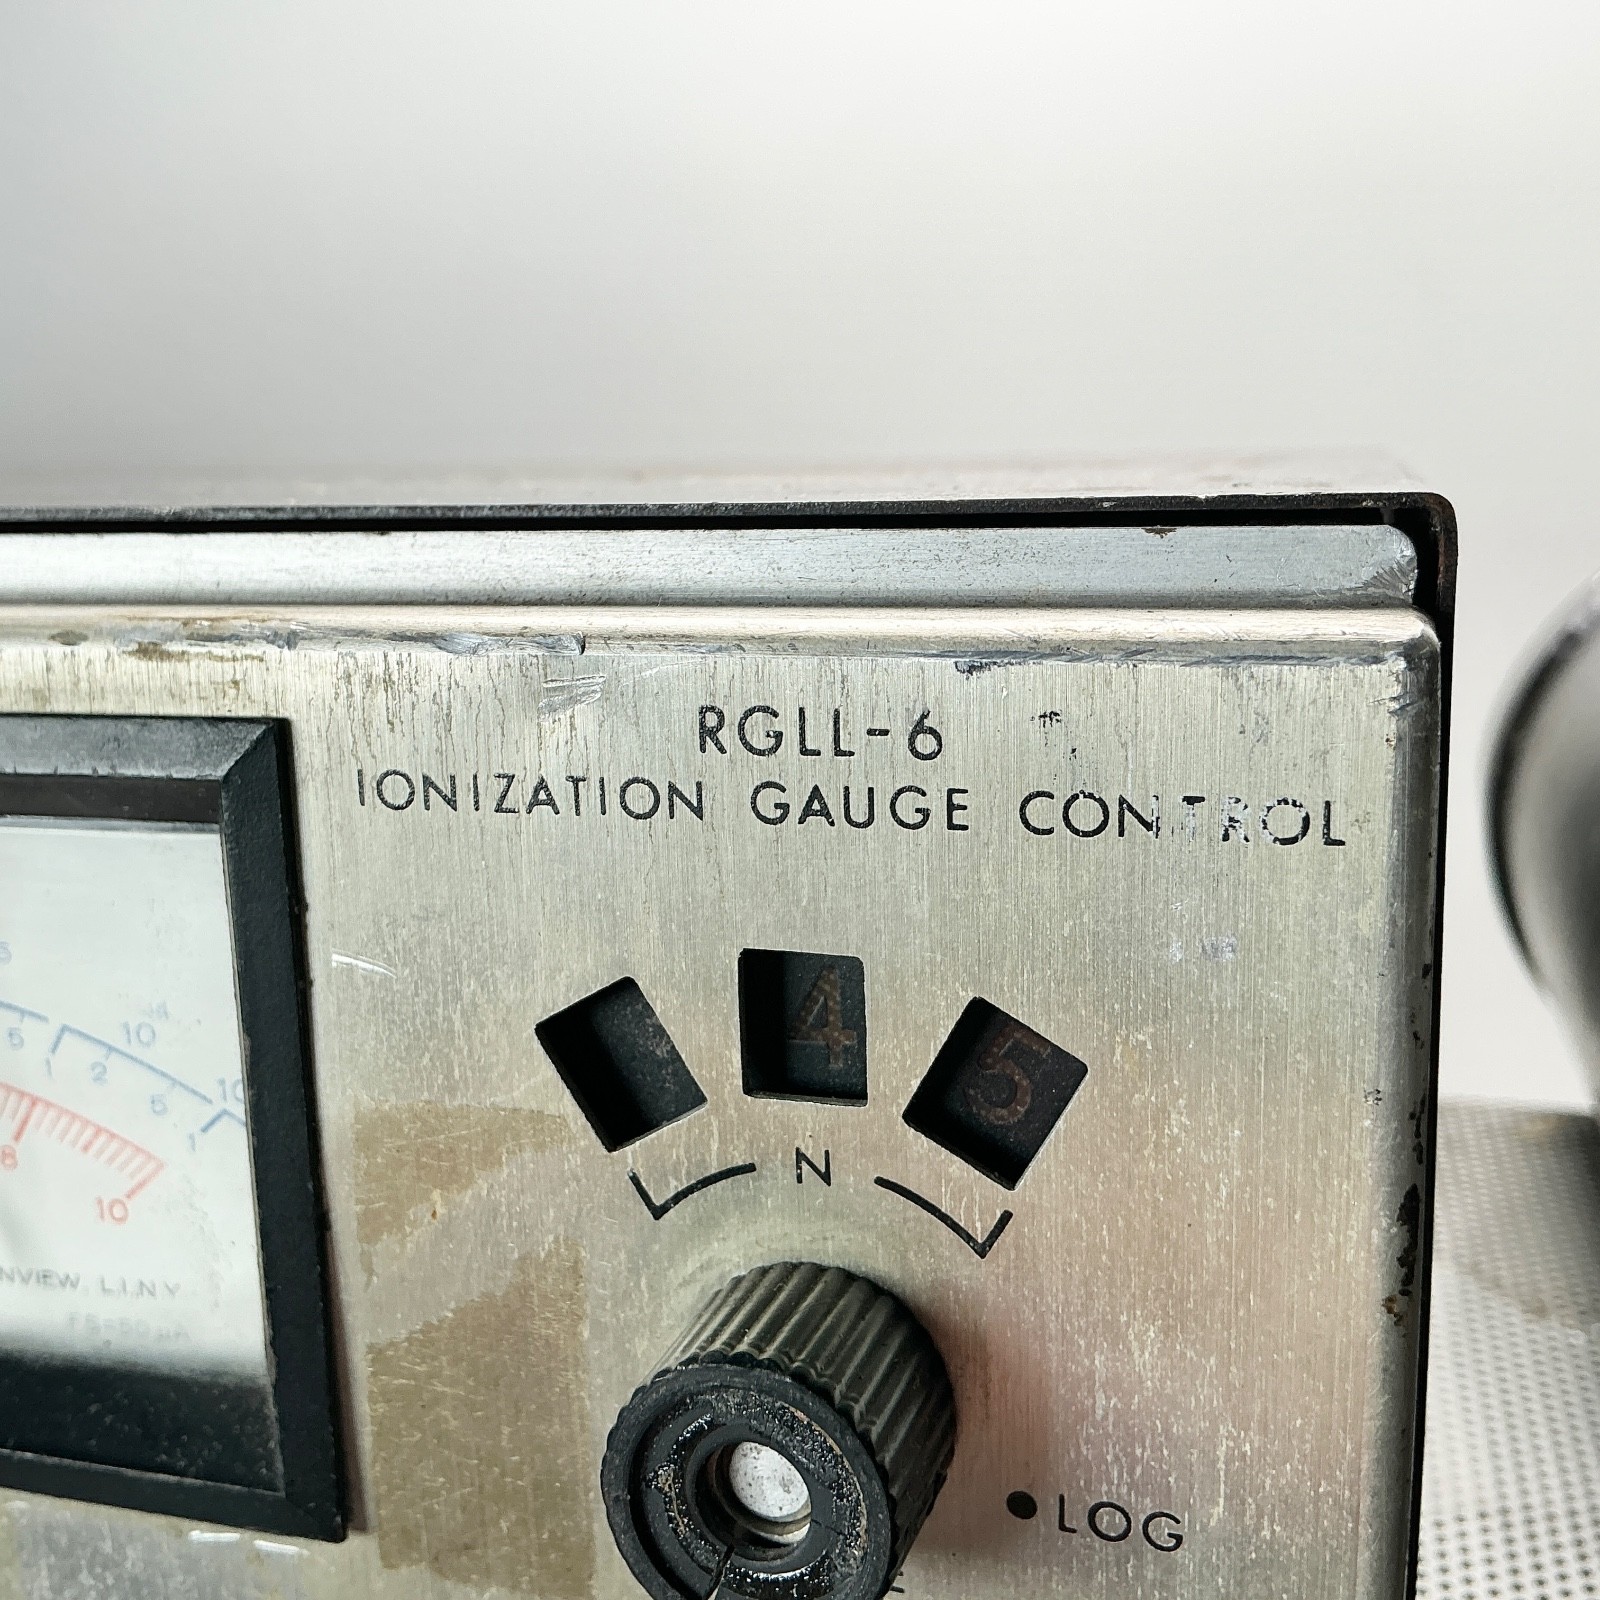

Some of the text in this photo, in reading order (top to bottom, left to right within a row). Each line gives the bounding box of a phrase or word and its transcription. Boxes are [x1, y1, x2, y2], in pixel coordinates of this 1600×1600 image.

[699, 704, 943, 761] RGLL-6
[358, 769, 1347, 847] IONIZATION GAUGE CONTROL
[788, 968, 858, 1070] 4
[90, 1059, 109, 1087] 2
[963, 1020, 1052, 1126] 5
[795, 1146, 832, 1187] N
[95, 1195, 130, 1225] 10
[1058, 1493, 1184, 1552] LOG
